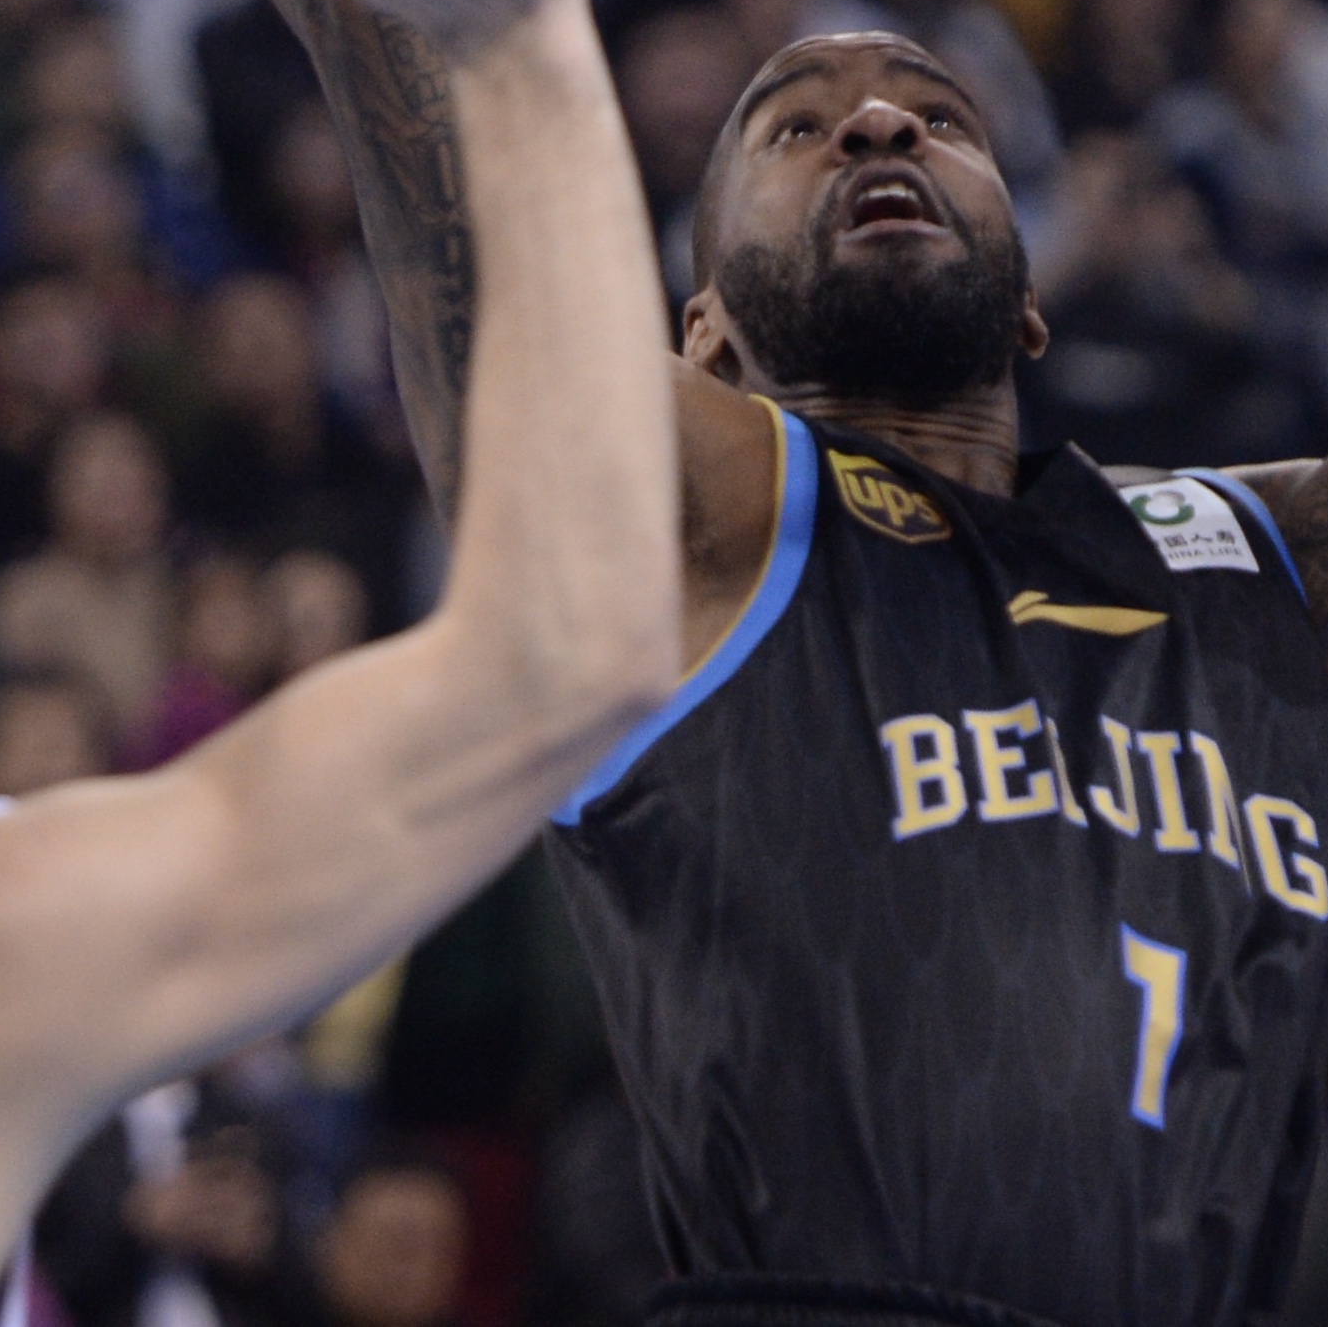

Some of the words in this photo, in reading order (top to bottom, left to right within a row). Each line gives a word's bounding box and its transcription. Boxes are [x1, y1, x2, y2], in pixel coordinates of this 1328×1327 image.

[845, 472, 943, 527] ups
[1164, 529, 1237, 548] 国人寿
[1120, 922, 1188, 1130] 1
